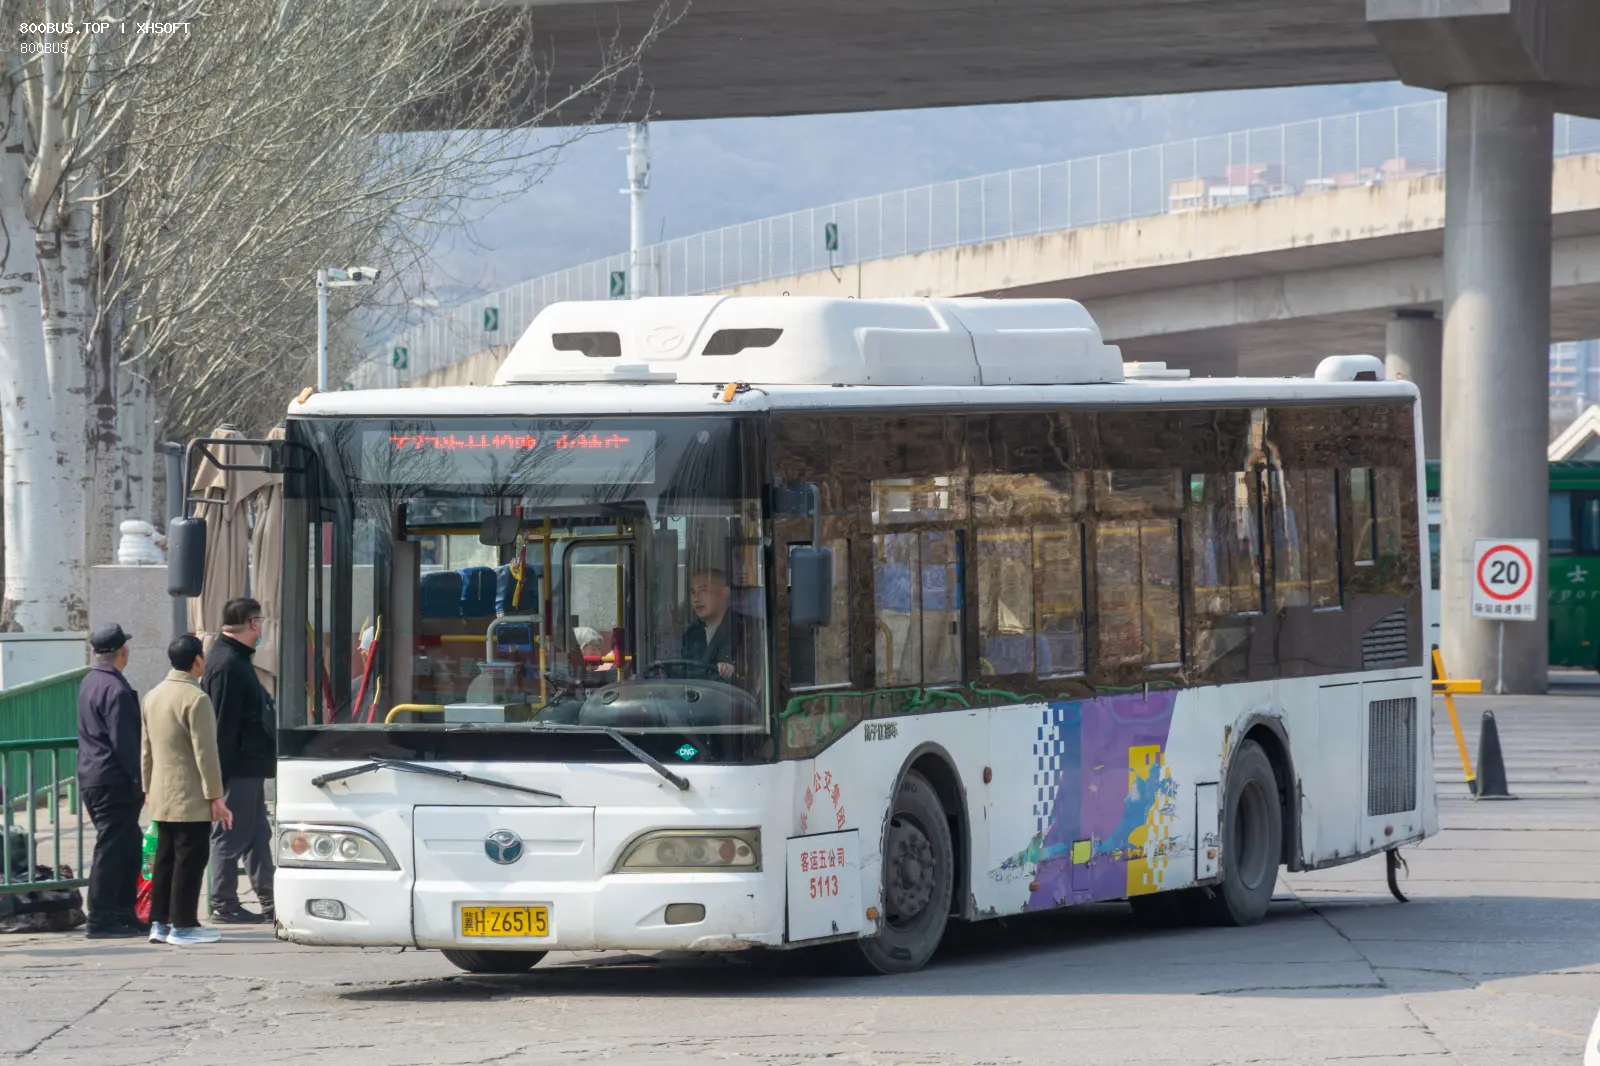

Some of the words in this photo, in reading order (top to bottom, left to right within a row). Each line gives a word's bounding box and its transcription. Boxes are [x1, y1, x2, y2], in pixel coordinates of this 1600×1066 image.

[1490, 559, 1520, 585] 20
[680, 747, 695, 756] CNG
[801, 847, 845, 873] 客运五公司
[809, 874, 839, 899] 5113
